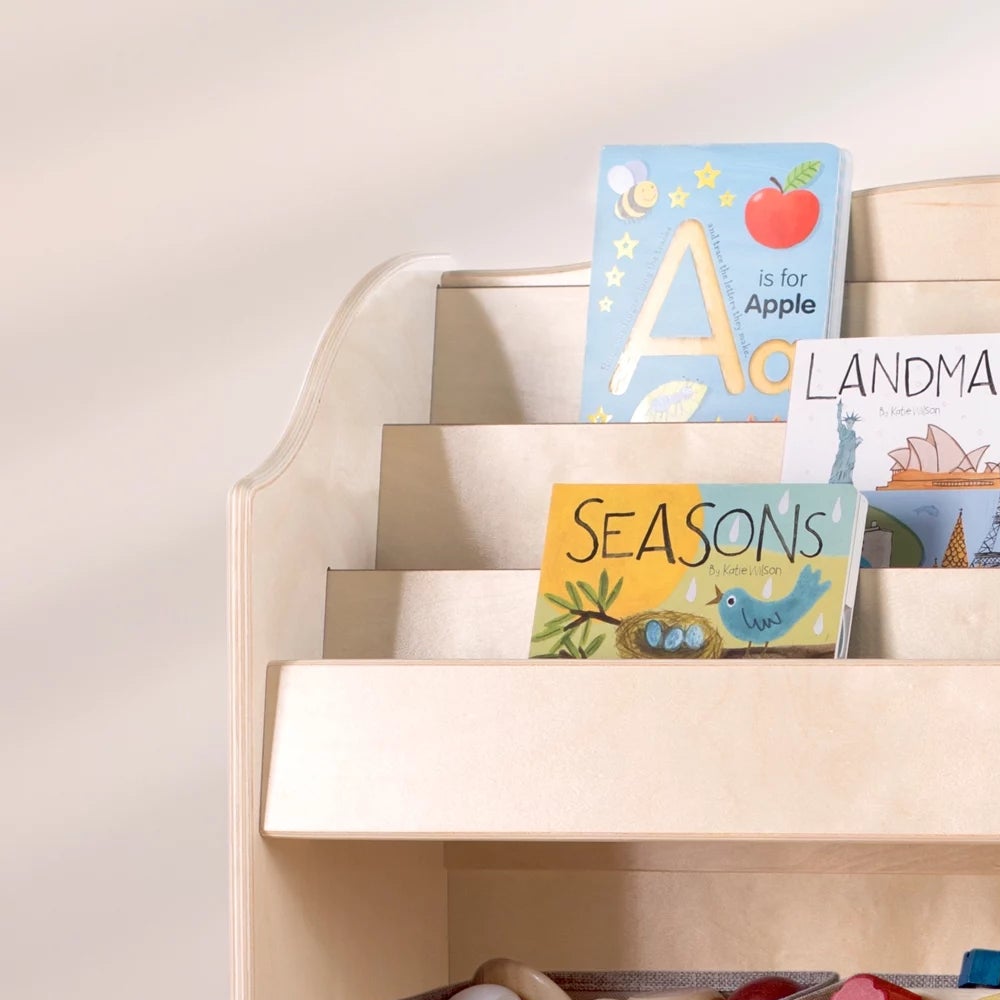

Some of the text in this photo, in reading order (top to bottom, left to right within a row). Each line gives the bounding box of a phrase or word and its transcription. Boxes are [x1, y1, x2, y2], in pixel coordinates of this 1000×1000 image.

[759, 268, 808, 287] is for
[744, 293, 816, 319] Apple
[566, 498, 826, 567] SEASONS
[709, 563, 783, 577] By Katie Wilson
